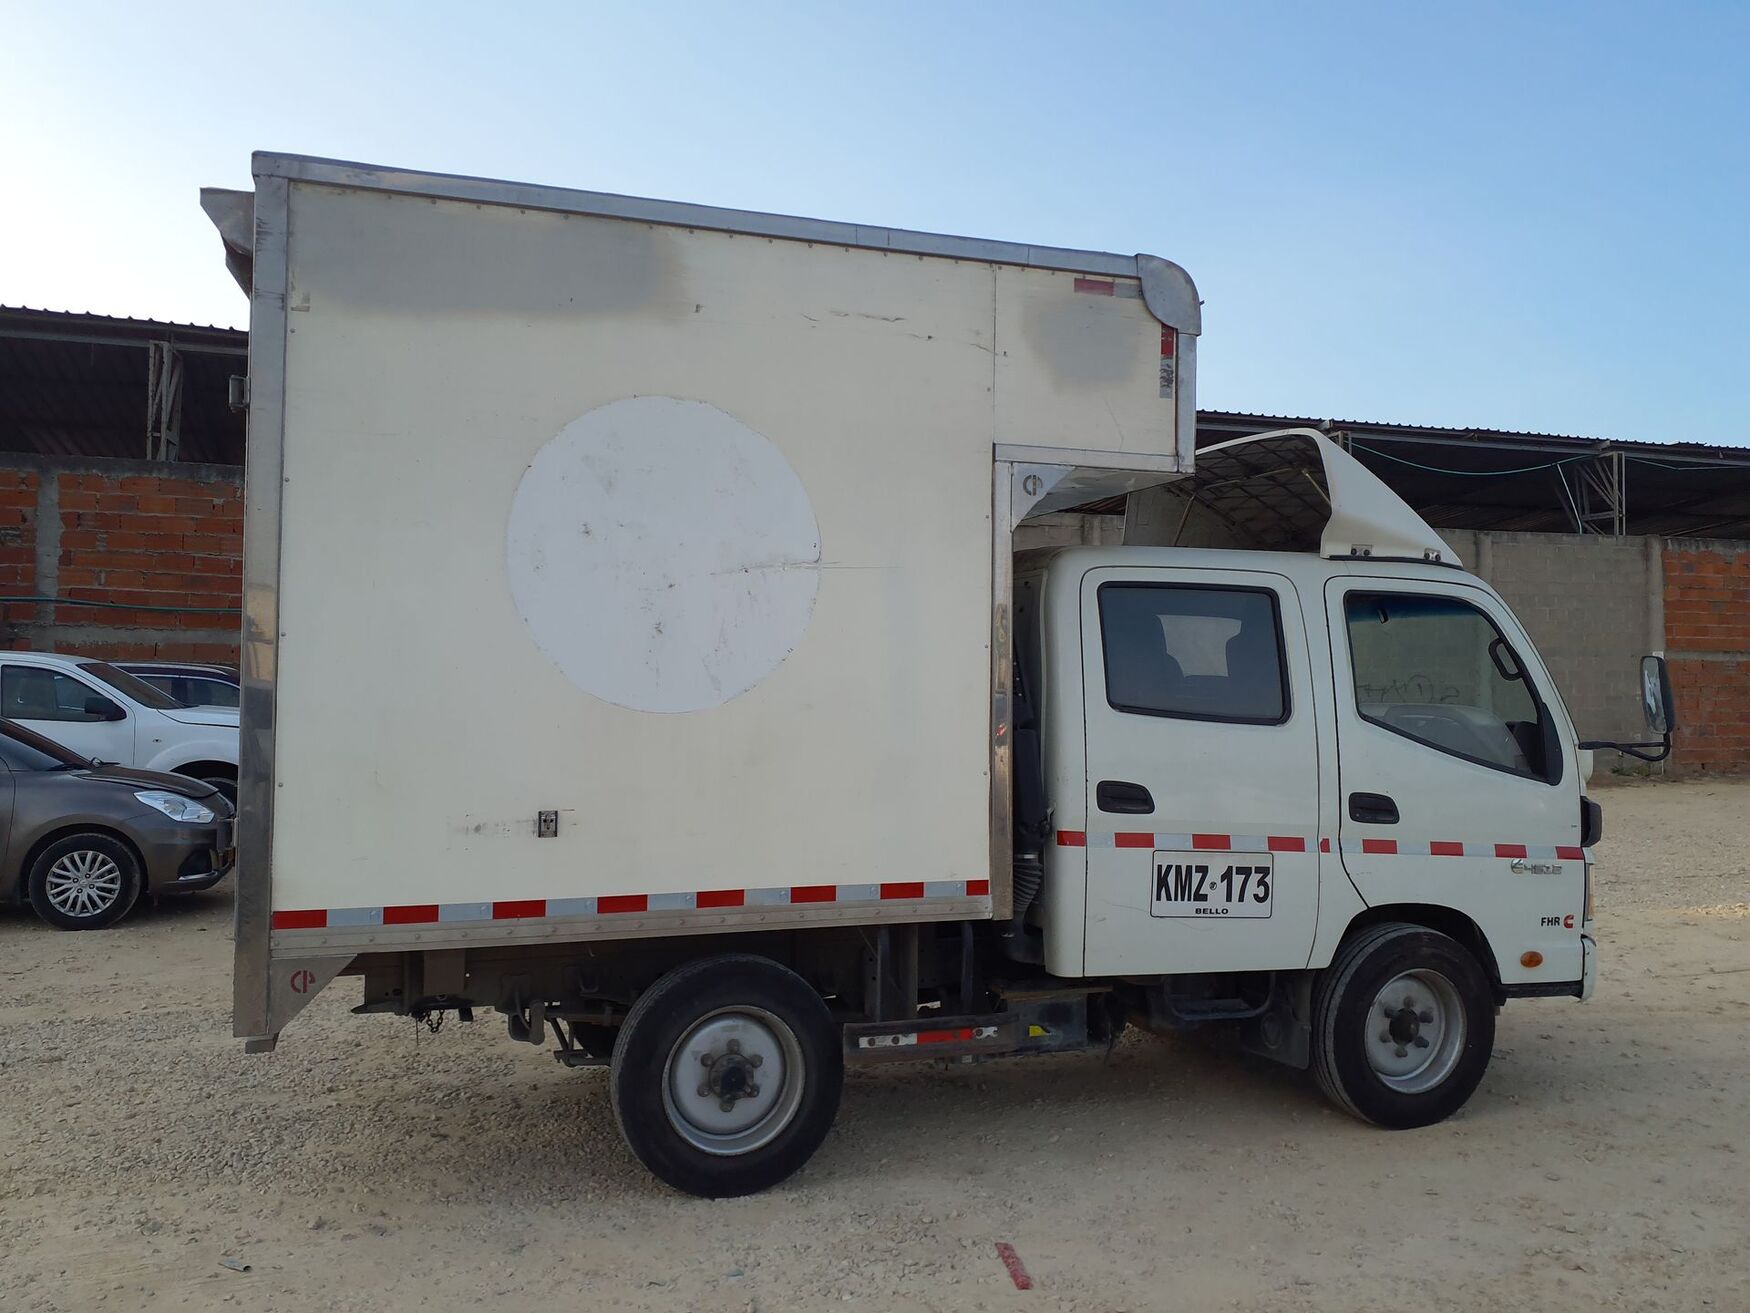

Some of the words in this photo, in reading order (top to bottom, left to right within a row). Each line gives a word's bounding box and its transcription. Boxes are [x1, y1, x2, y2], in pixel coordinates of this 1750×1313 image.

[1156, 864, 1209, 902] KMZ
[1220, 865, 1270, 903] 173
[1541, 917, 1560, 927] FHR
